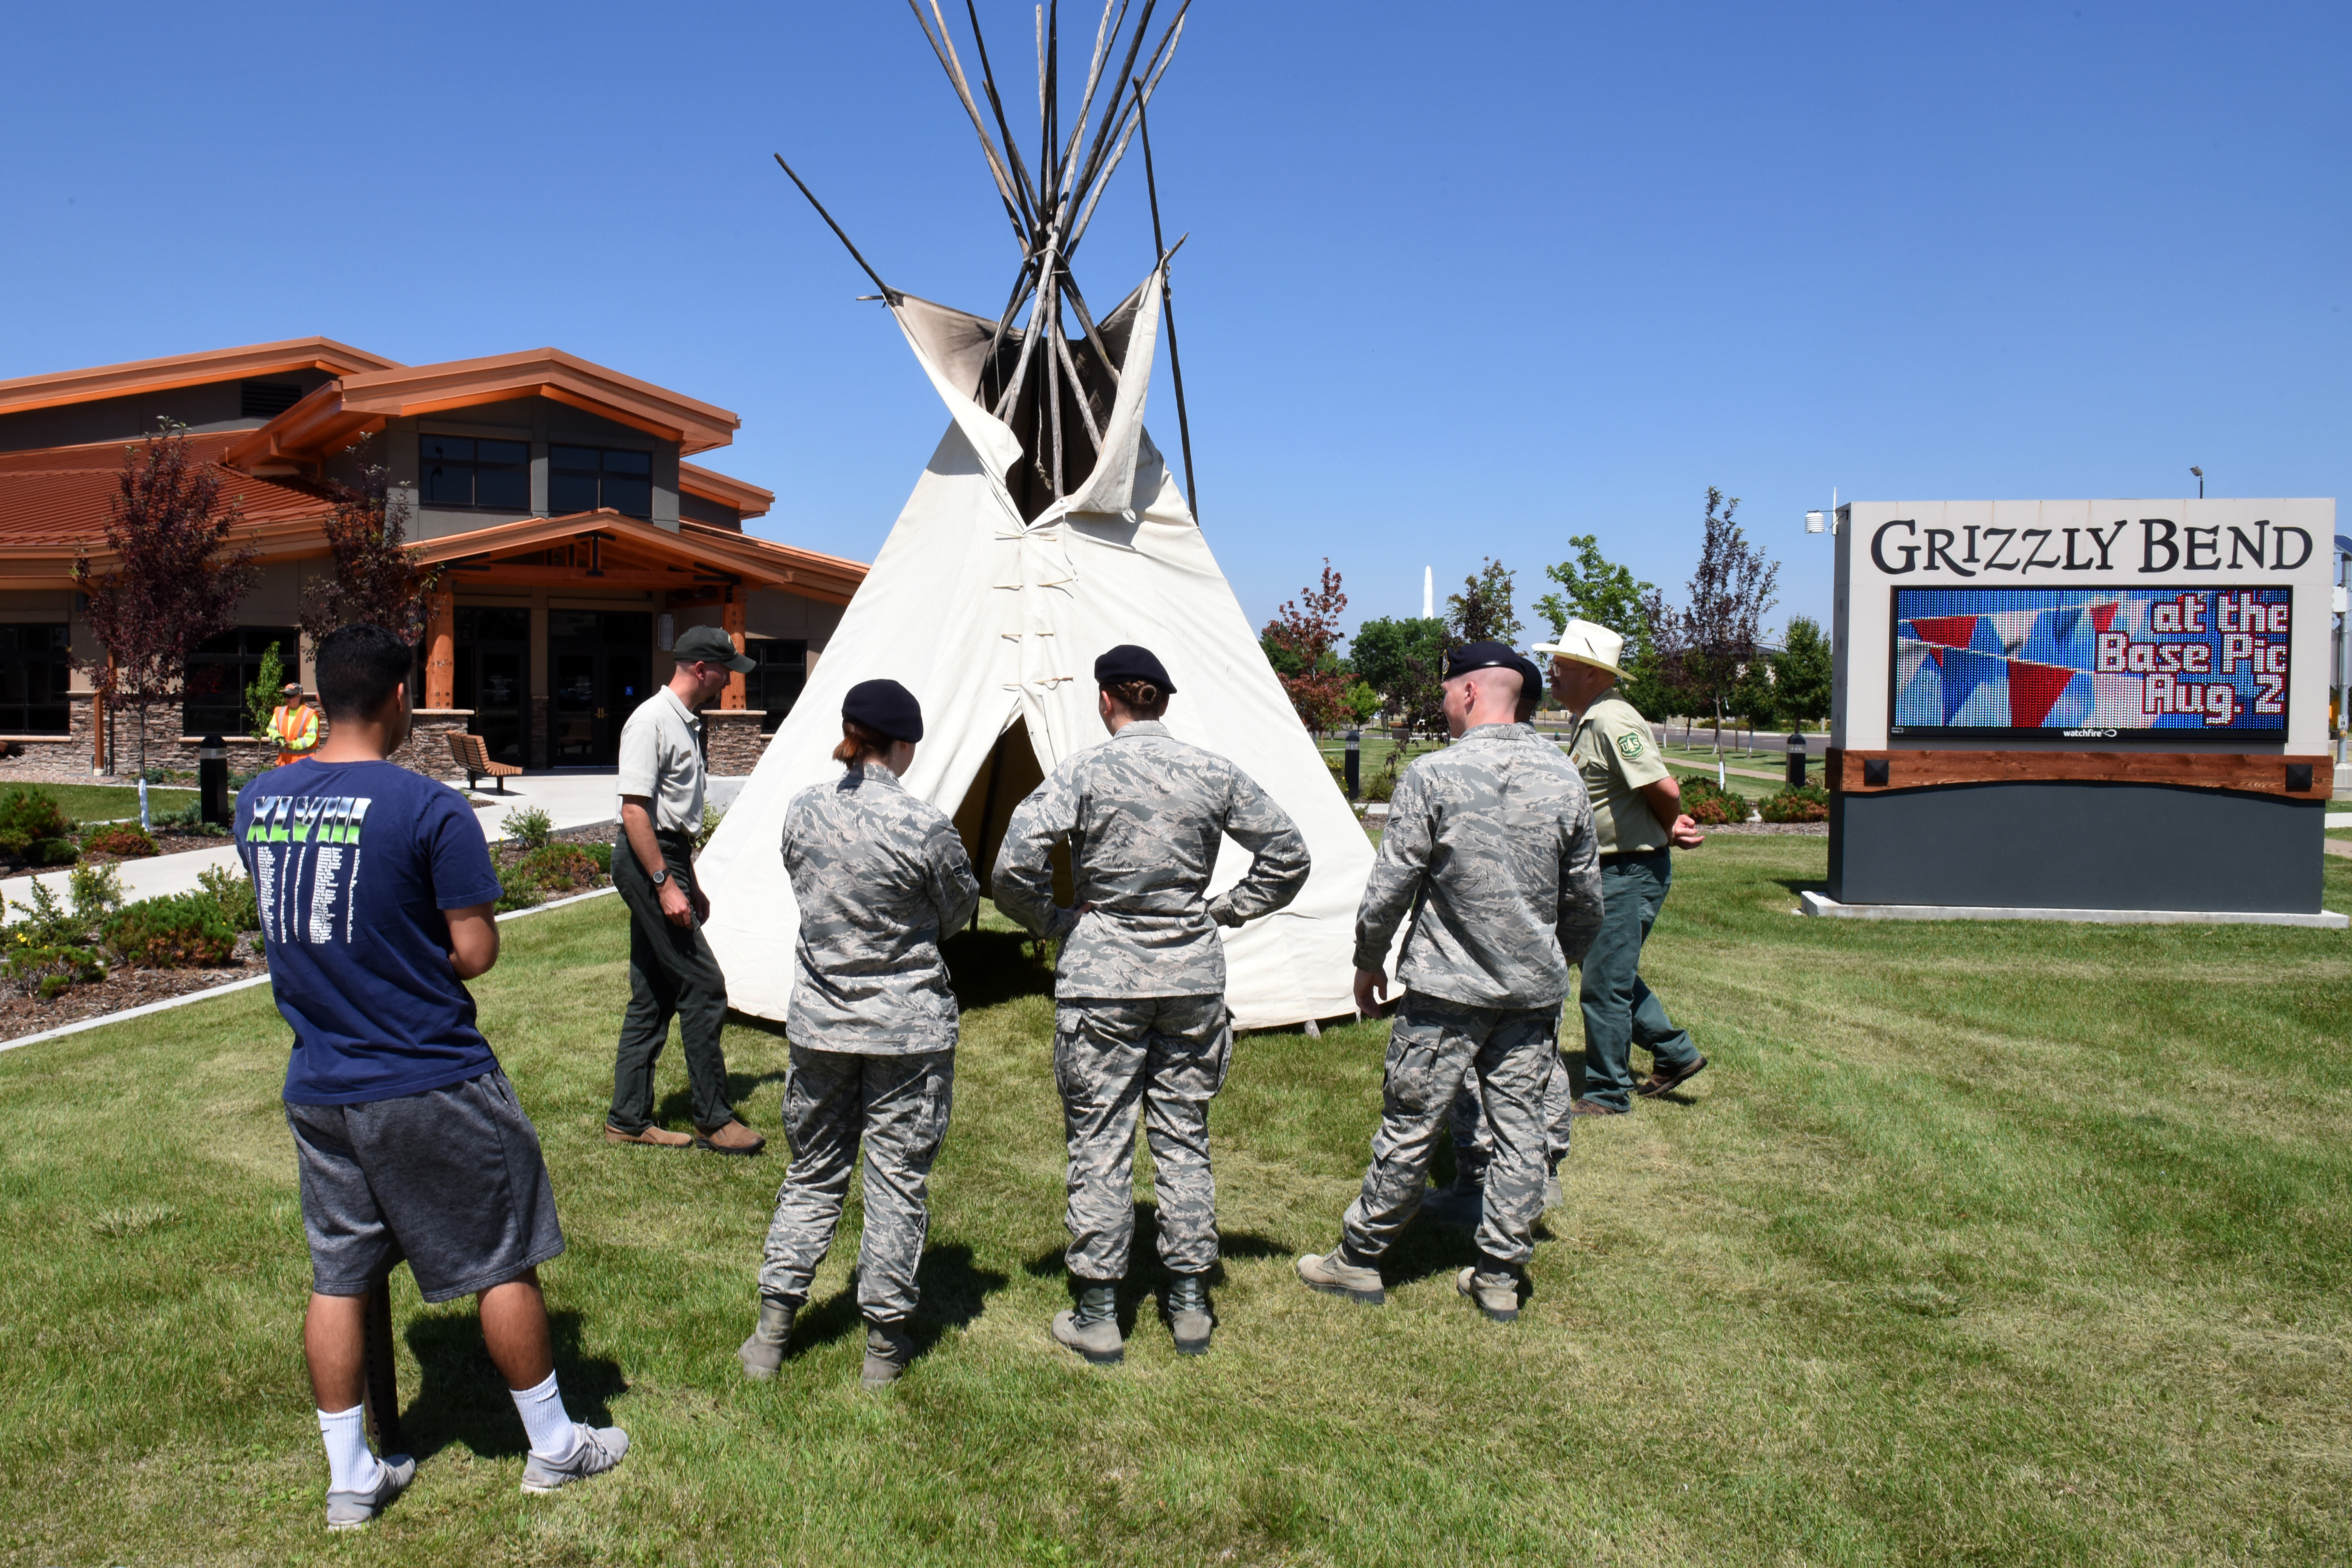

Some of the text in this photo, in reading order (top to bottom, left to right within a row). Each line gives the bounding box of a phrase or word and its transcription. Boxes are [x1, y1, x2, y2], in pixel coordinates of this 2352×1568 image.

[1871, 519, 2313, 577] GRIZZLY BEND
[2154, 593, 2289, 631] at the
[2097, 633, 2287, 672] Base Pic
[2145, 673, 2283, 724] Aug. 2
[2063, 729, 2102, 737] watchfire
[246, 796, 372, 845] XLVIII
